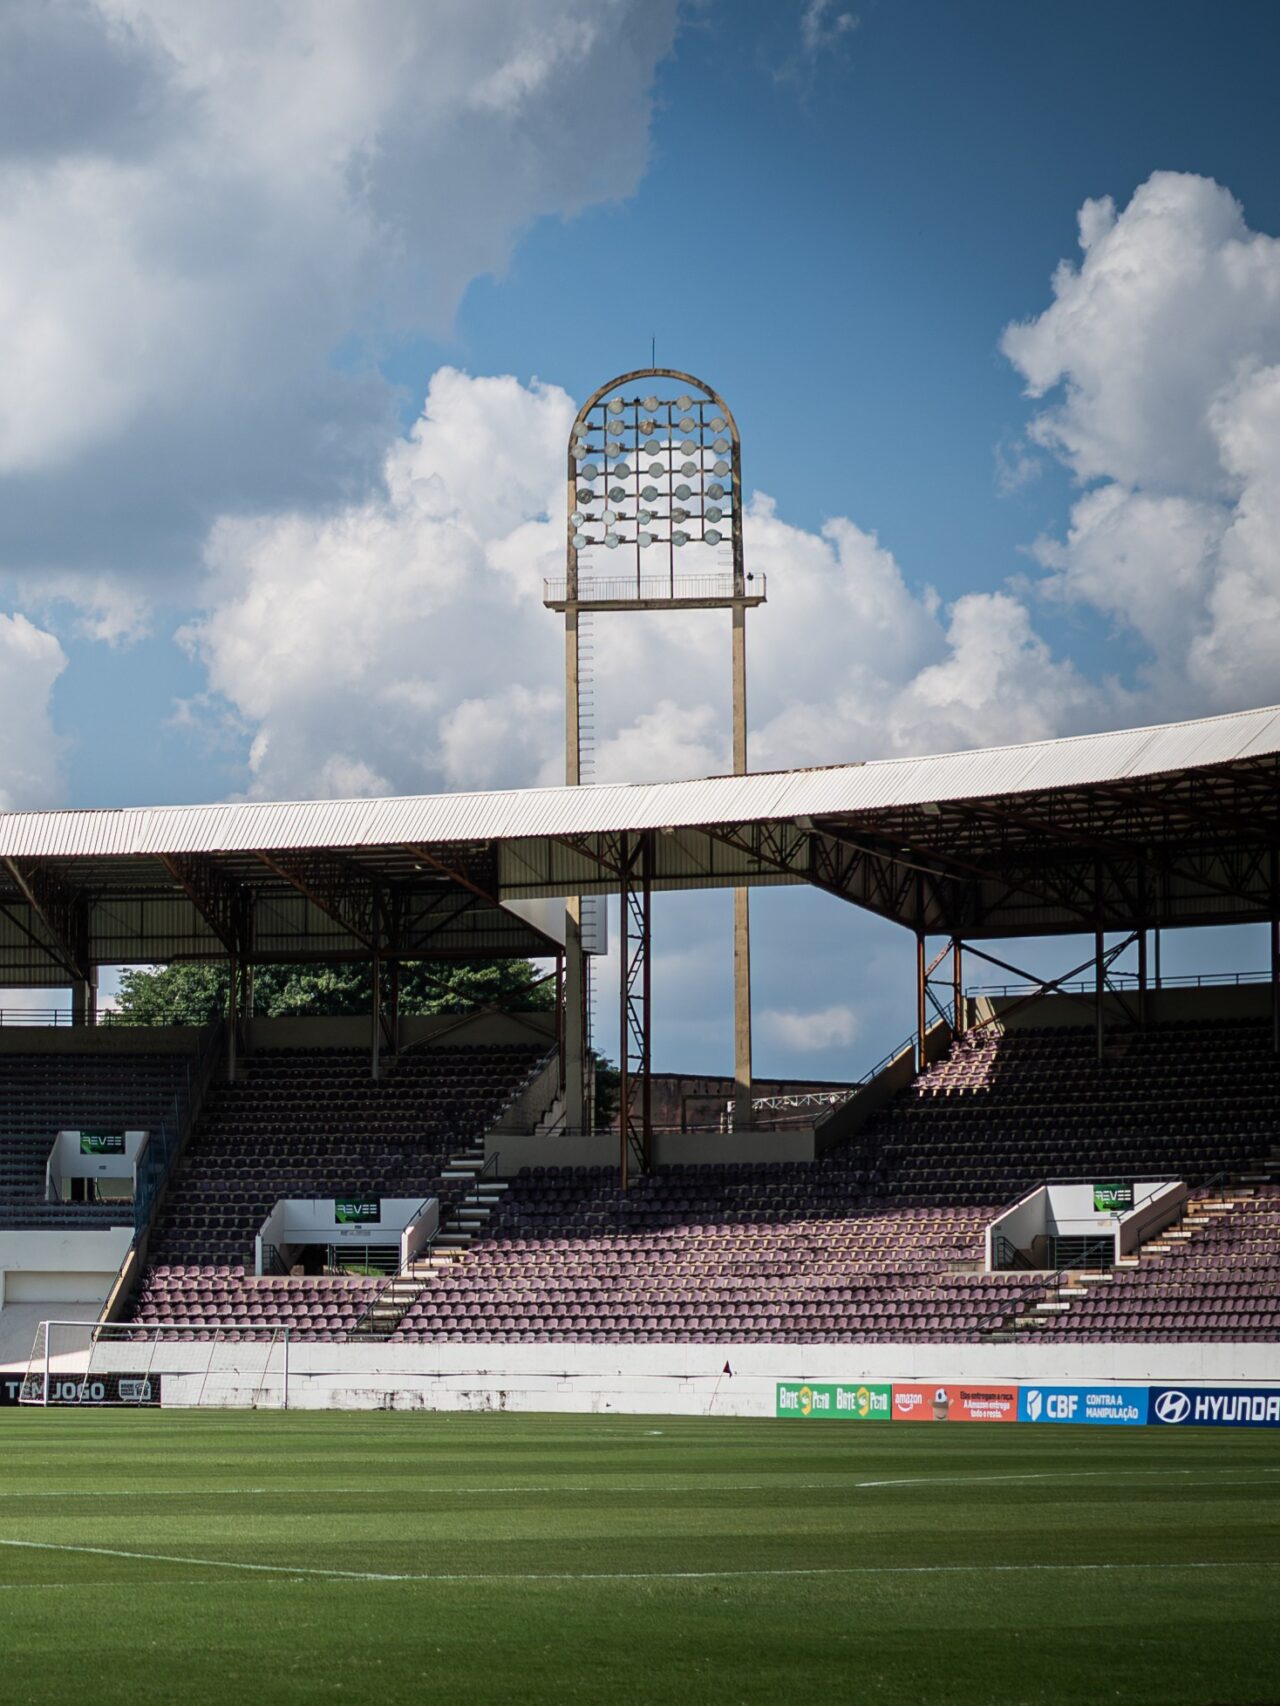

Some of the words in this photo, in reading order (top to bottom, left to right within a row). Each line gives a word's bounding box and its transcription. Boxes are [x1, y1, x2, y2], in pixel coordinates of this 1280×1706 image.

[82, 1136, 122, 1146] REVEE
[1095, 1189, 1132, 1201] REVEE
[337, 1204, 377, 1214] REVEE
[5, 1382, 44, 1399] TEM
[52, 1382, 105, 1400] JOGO
[895, 1393, 923, 1405] amazon
[1086, 1394, 1115, 1405] CONTRA
[1115, 1395, 1123, 1406] A
[1047, 1395, 1078, 1418] CBF
[1194, 1396, 1280, 1421] HYUNDA
[1086, 1405, 1138, 1421] MANIPULAÇÃO
